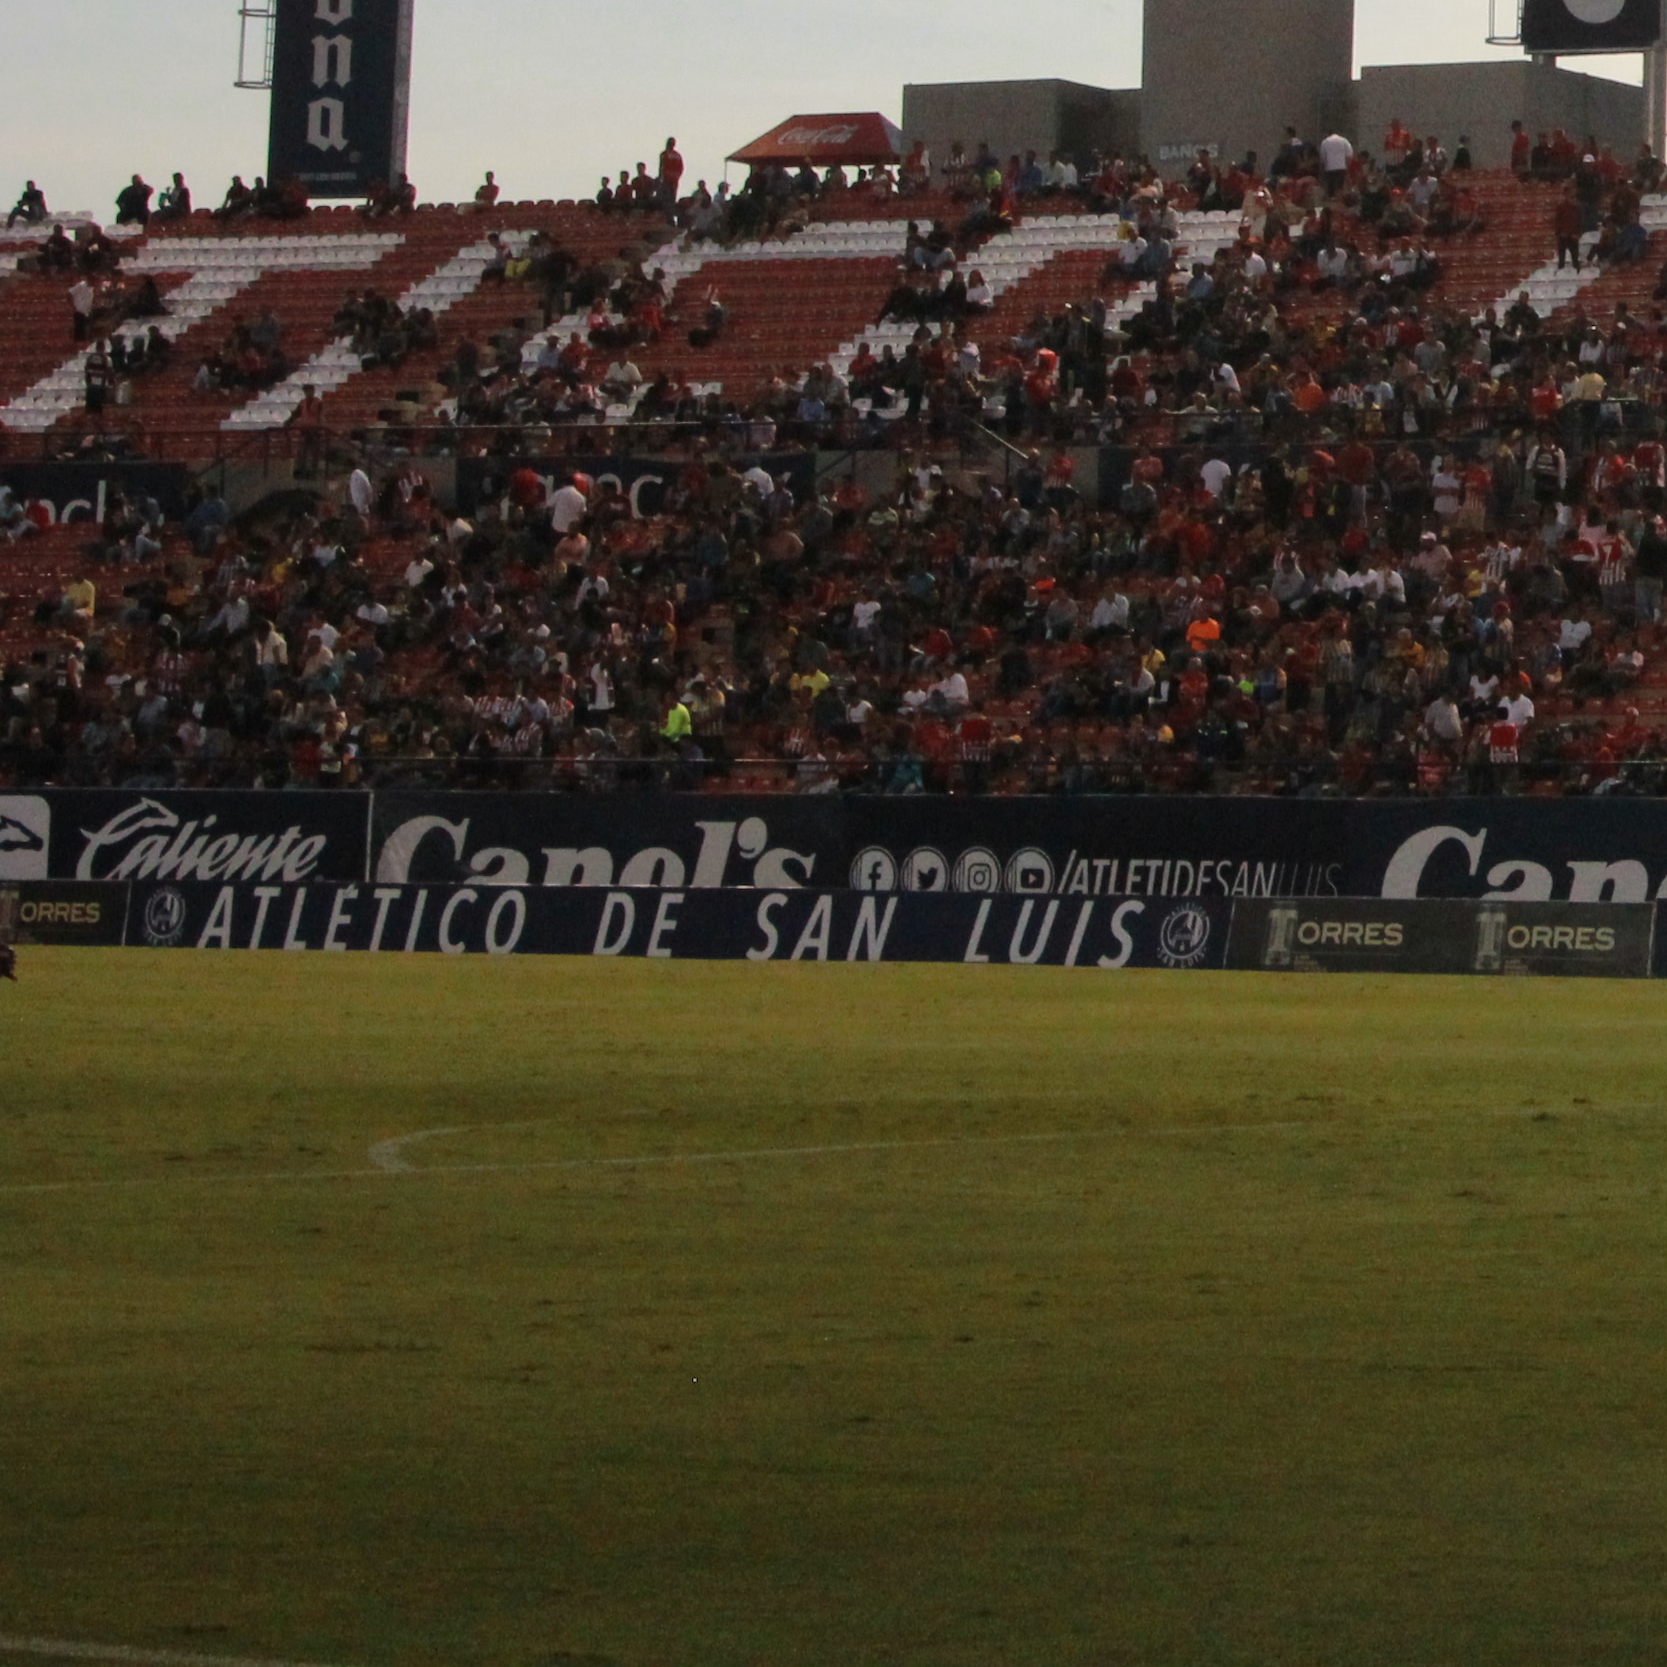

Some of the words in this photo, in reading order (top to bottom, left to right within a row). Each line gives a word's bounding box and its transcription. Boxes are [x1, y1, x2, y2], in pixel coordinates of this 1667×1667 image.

[77, 798, 327, 880] Caliente
[197, 885, 527, 955] ATLÉTICO
[592, 892, 685, 959] DE
[746, 893, 899, 962] SAN
[963, 898, 1146, 969] LUIS
